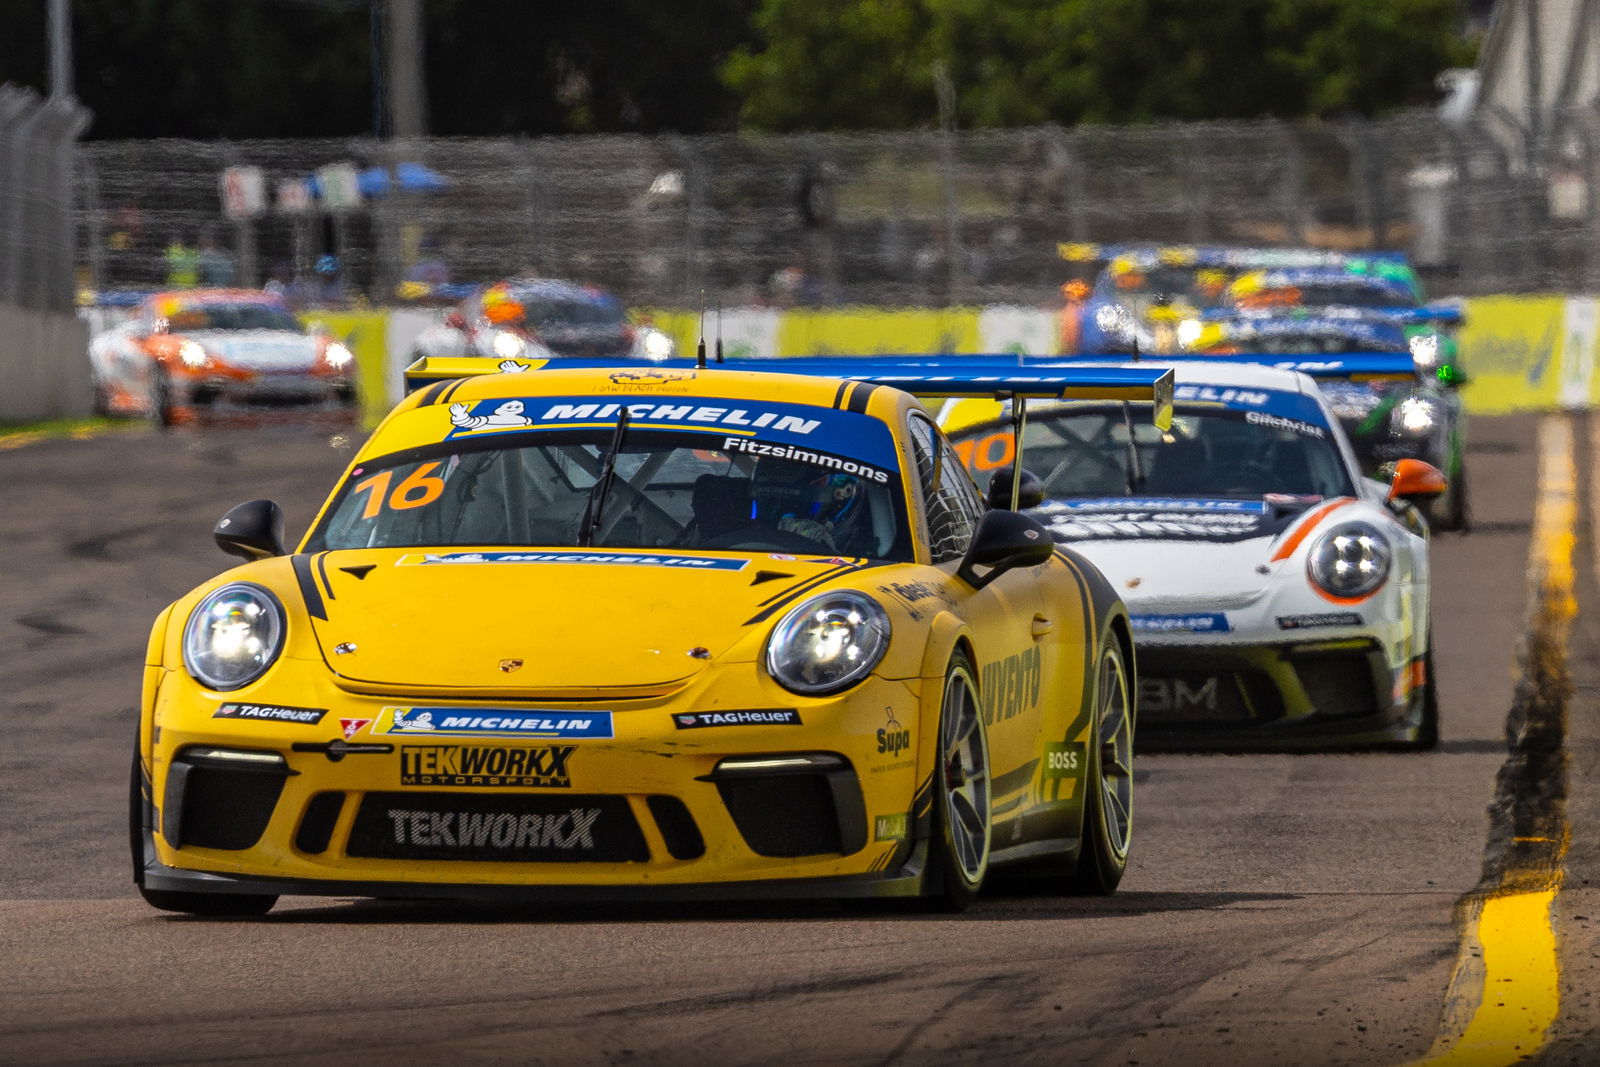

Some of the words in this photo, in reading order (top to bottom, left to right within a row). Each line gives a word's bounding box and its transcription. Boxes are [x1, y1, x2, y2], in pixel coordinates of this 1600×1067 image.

[1173, 385, 1269, 404] ELIN
[541, 403, 822, 435] MICHELIN
[722, 436, 889, 484] Fitzsimmons
[354, 461, 445, 519] 16
[498, 555, 716, 566] MICHELIN
[440, 716, 592, 730] MICHELIN
[876, 728, 910, 757] Supa
[1048, 751, 1078, 769] BOSS
[402, 775, 568, 785] MOTORSPORT
